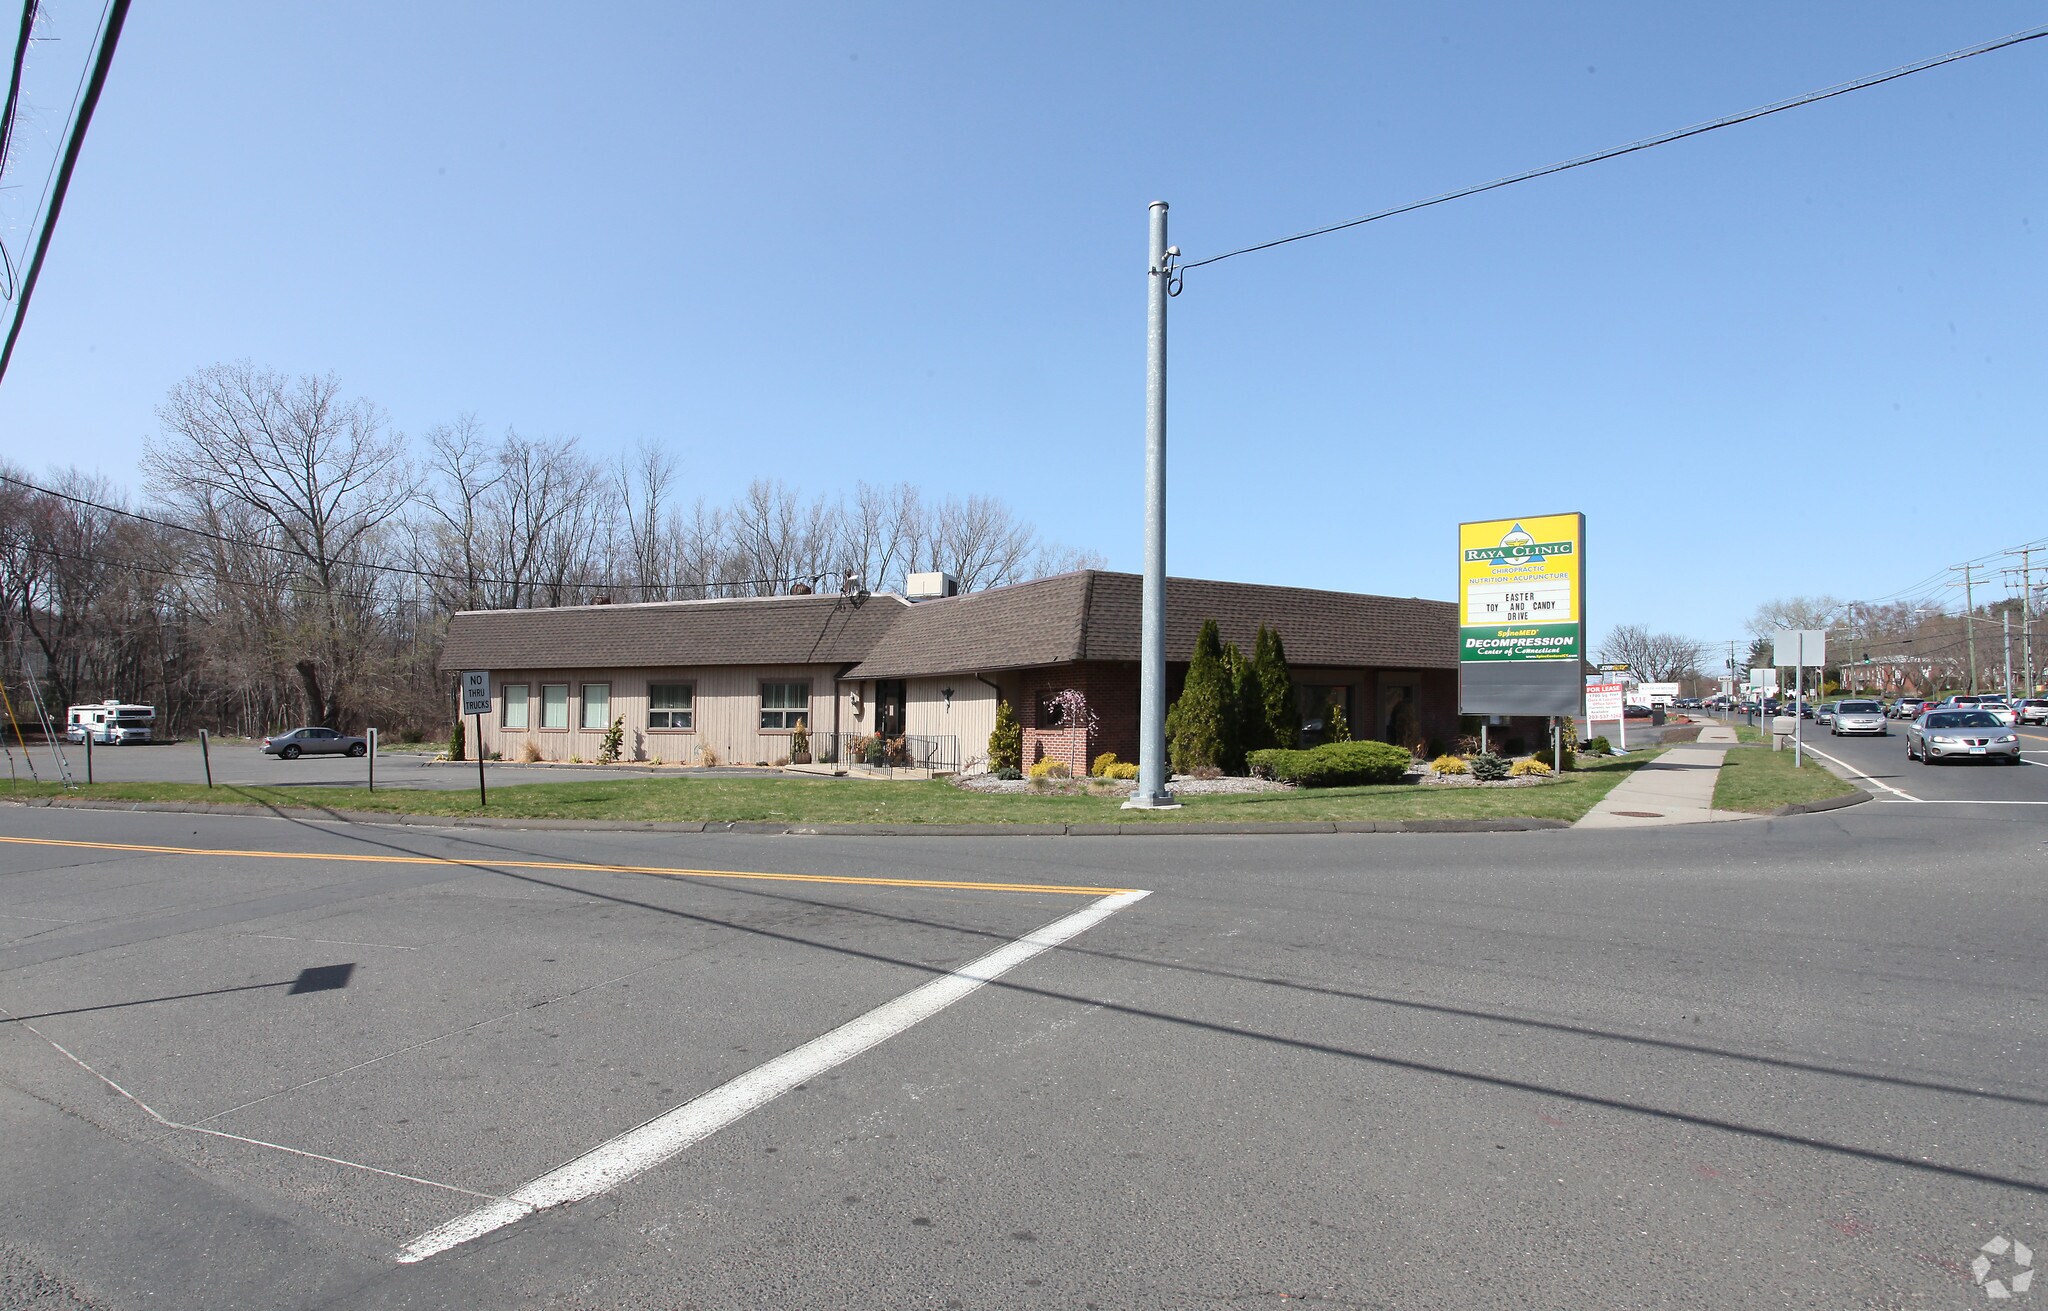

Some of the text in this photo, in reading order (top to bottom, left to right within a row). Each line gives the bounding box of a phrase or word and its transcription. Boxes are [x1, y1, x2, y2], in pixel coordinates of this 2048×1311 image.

[1467, 545, 1570, 560] RAYA CLINIC
[1492, 566, 1545, 575] CHIROPRACTIC
[1469, 573, 1568, 584] NUTRITION ACUPUNCTURE
[1505, 592, 1534, 602] EASTER
[1486, 601, 1555, 612] TOY AND CANDY
[1507, 612, 1529, 621] DRIVE
[1465, 637, 1574, 648] DECOMPRESSION
[1477, 646, 1560, 656] Center of Connecticut
[470, 675, 482, 685] NO
[468, 689, 485, 698] THRU
[466, 701, 490, 710] TRUCKS
